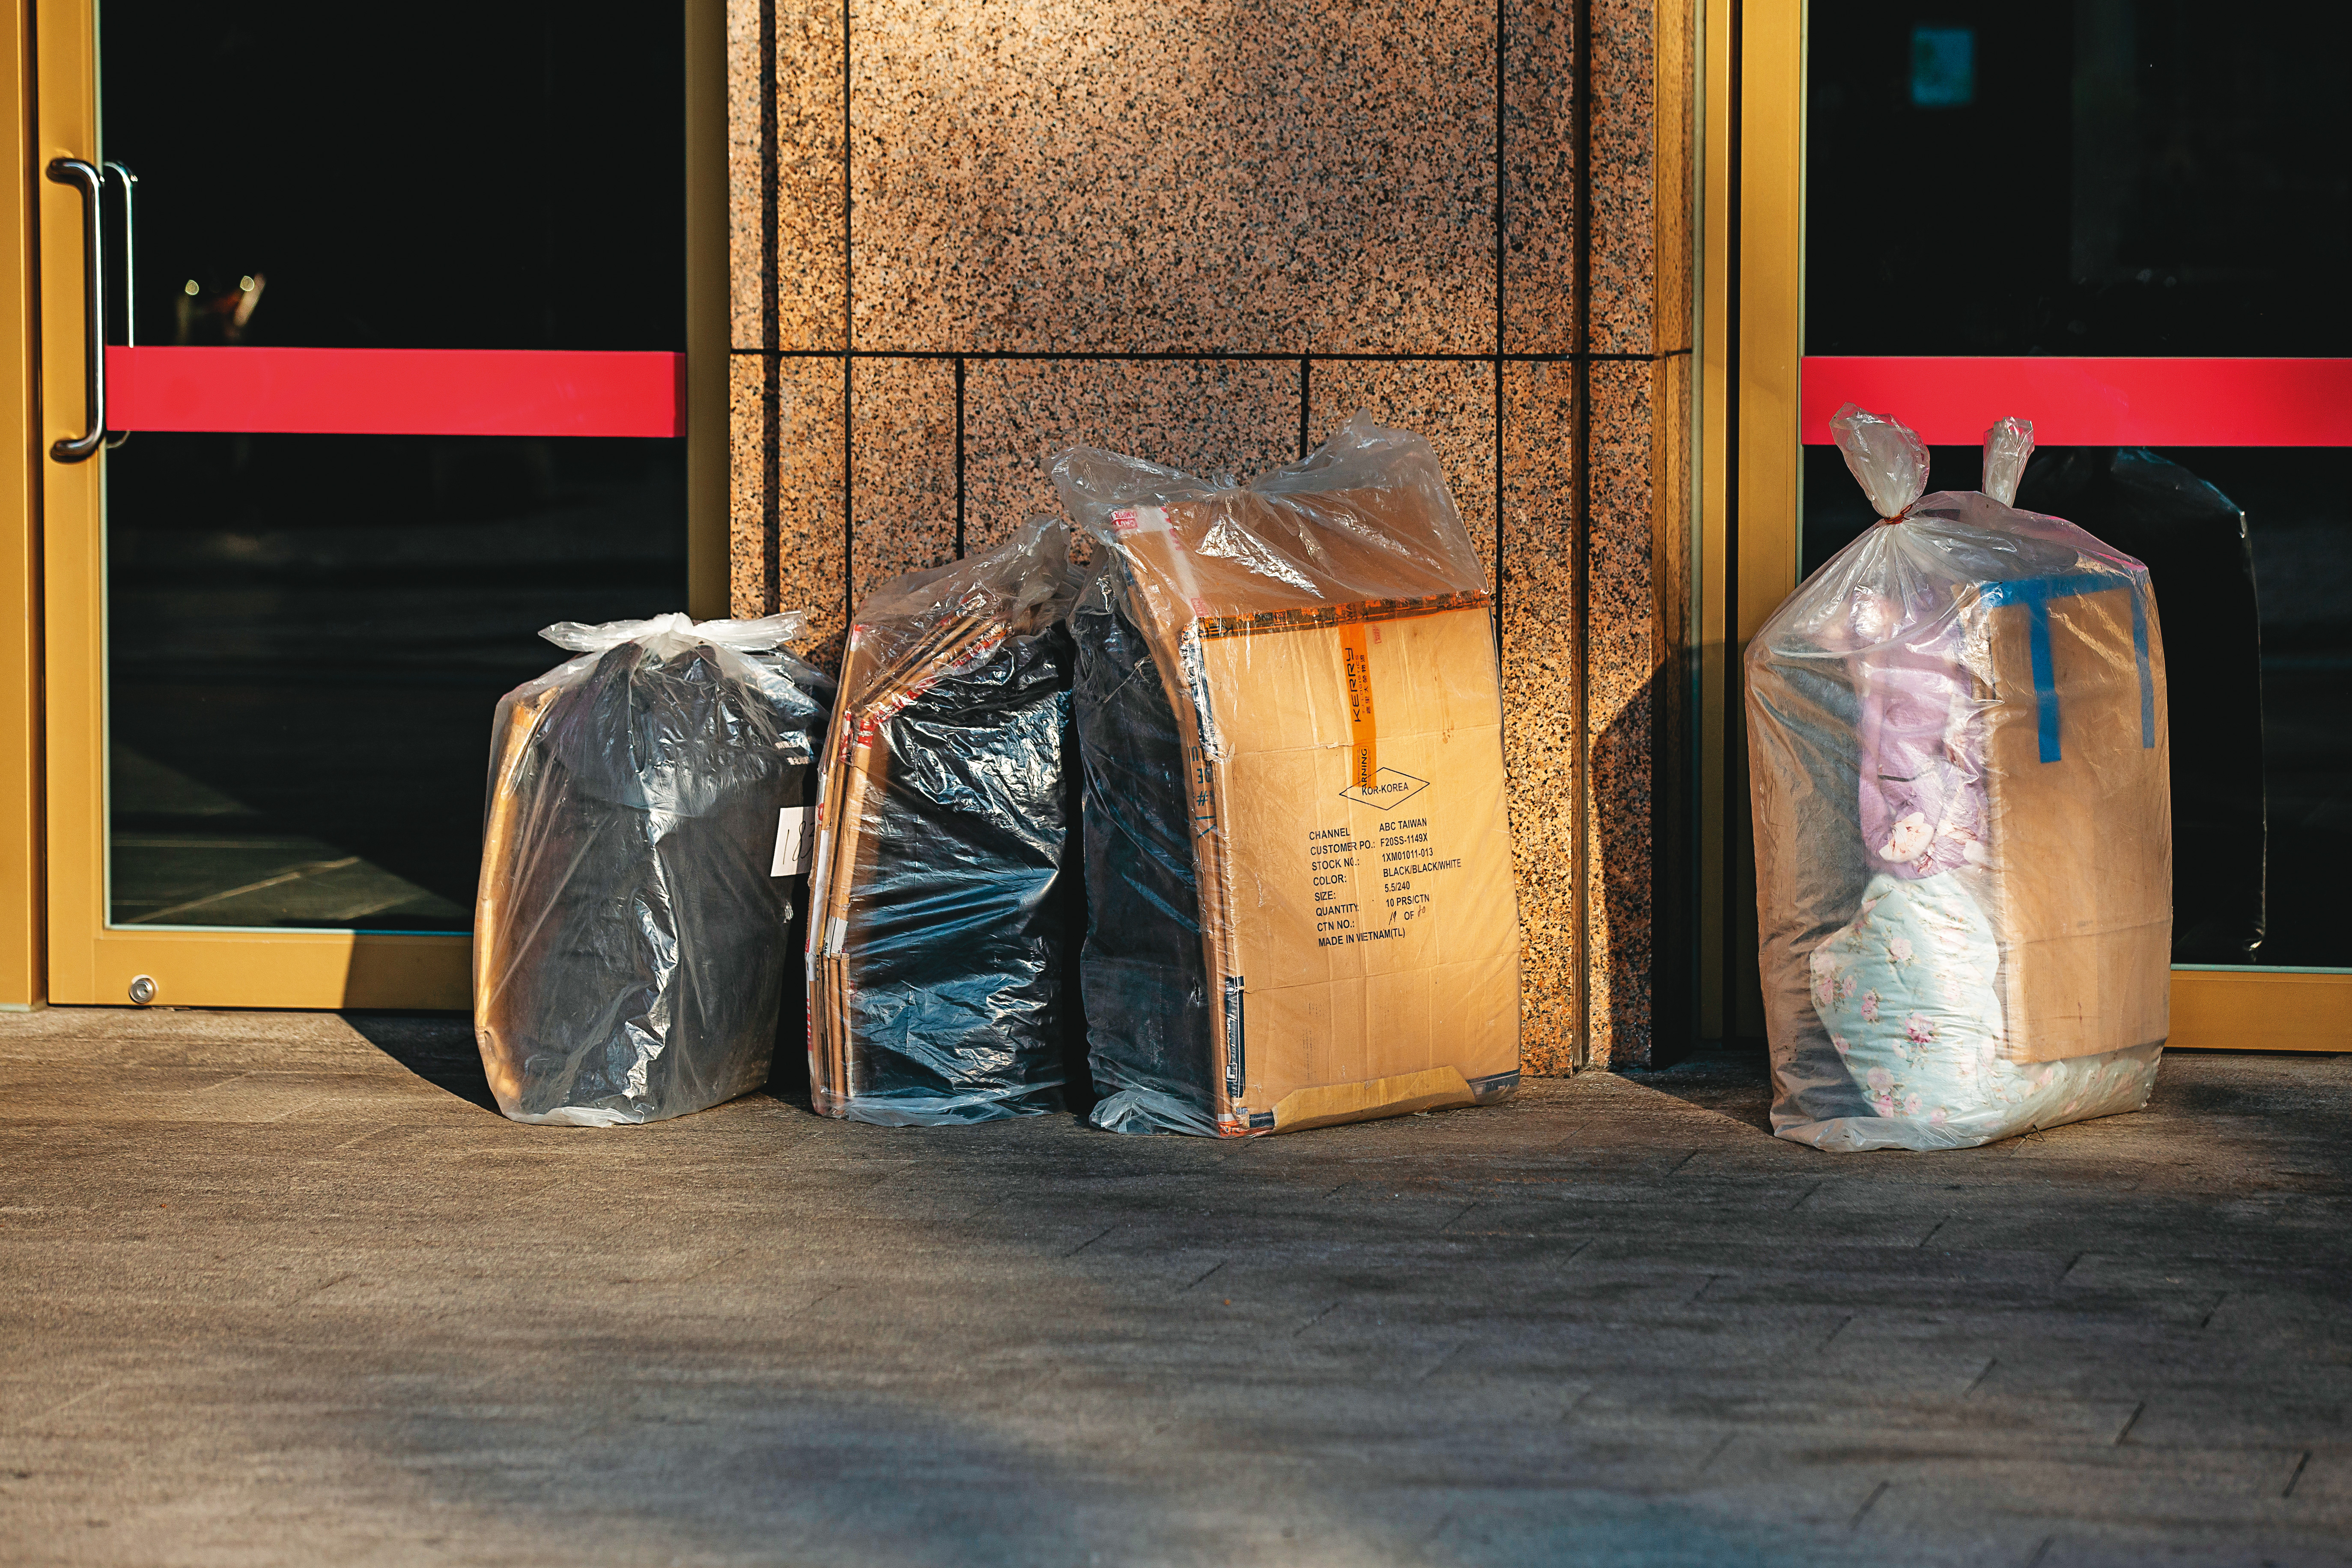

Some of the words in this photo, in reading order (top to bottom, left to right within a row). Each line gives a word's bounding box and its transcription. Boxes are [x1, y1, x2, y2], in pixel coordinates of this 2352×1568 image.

[1345, 648, 1361, 722] KERRY
[1355, 655, 1364, 701] LOGISTICS
[1362, 782, 1409, 796] KOR-KOREA
[1379, 822, 1396, 832] ABC
[1398, 817, 1427, 830] TAIWAN
[1309, 827, 1350, 840] CHANNEL
[1380, 832, 1428, 847] F20SS-1149X
[1310, 842, 1357, 856] CUSTOMER
[1359, 840, 1375, 850] PO.:
[1382, 847, 1434, 862] 1XM01011-013
[1312, 859, 1342, 871] STOCK
[1383, 859, 1462, 877] BLACK/BLACK/WHITE
[1313, 874, 1347, 886] COLOR:
[1385, 881, 1410, 893] 5.5/240
[1315, 891, 1336, 901] SIZE:
[1386, 898, 1395, 907] 10
[1396, 893, 1430, 906] PRS/CTN
[1316, 903, 1359, 917] QUANTITY:
[1404, 911, 1414, 920] OF
[1317, 921, 1334, 932] CTN
[1337, 919, 1355, 930] NO.:
[1318, 935, 1344, 947] MADE
[1346, 934, 1354, 944] IN
[1356, 927, 1405, 942] VIETNAM(TL)
